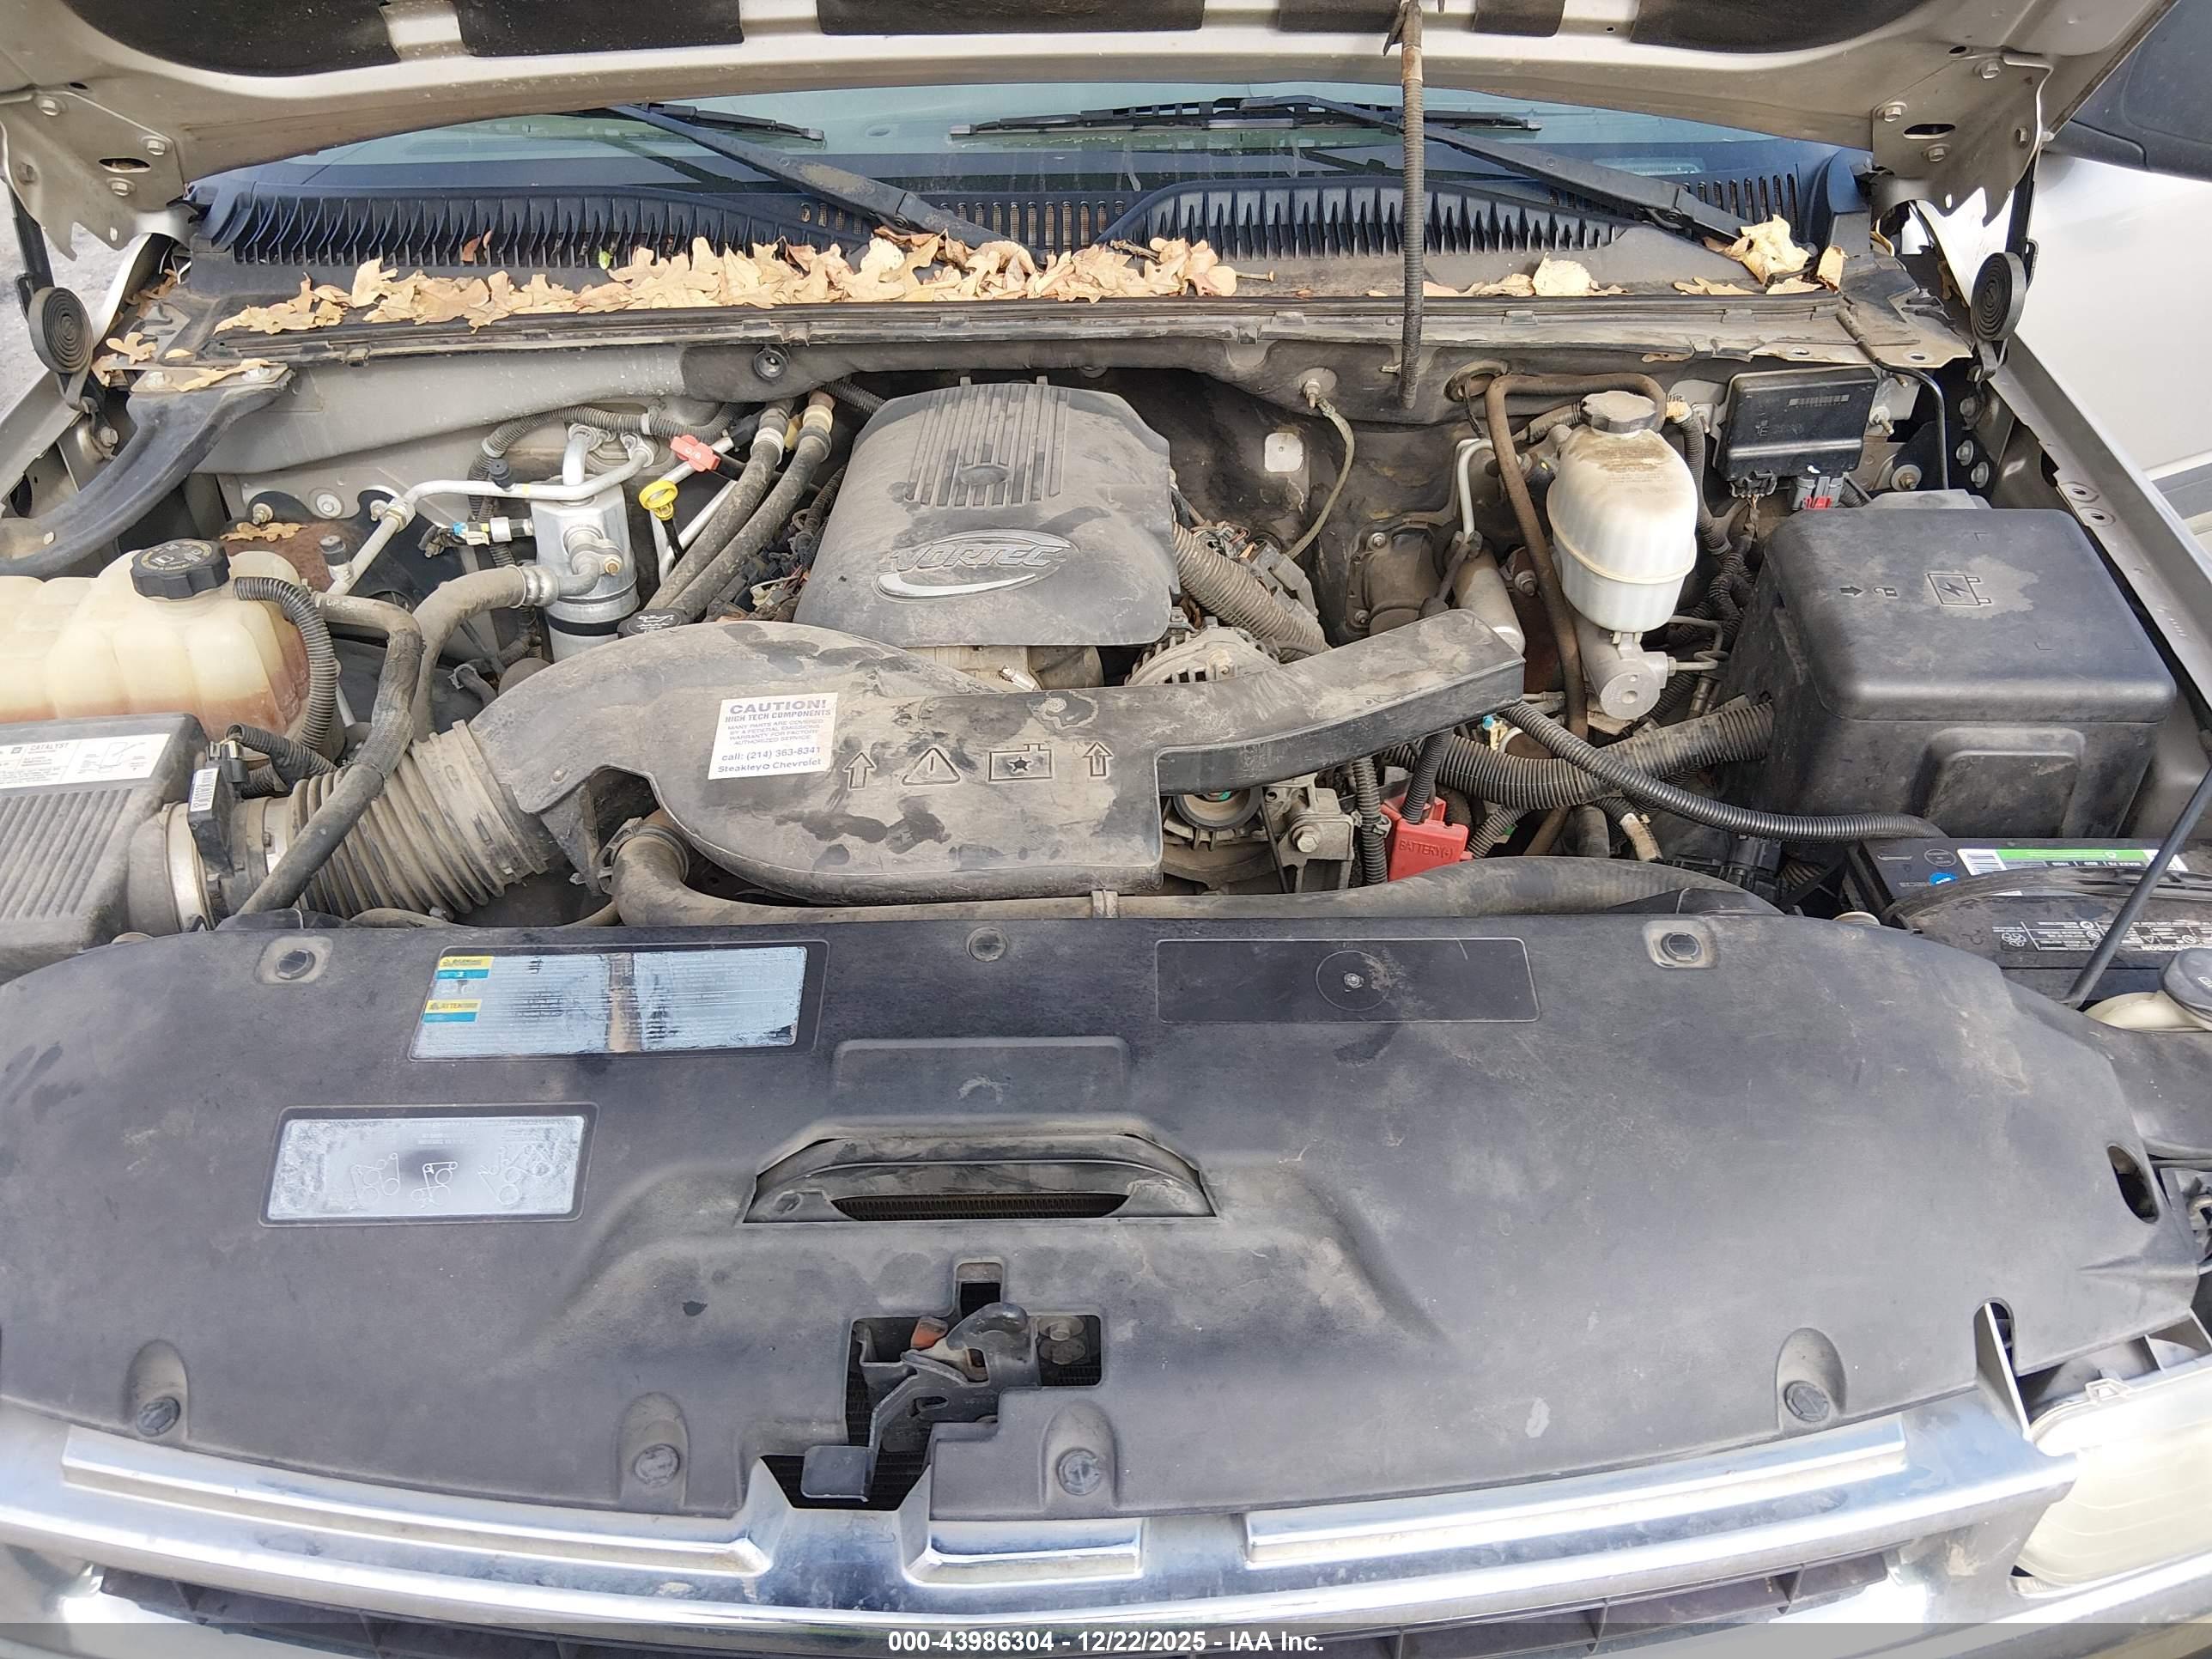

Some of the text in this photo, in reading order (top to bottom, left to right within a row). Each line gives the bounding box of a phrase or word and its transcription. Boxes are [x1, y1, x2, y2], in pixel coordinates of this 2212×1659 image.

[889, 544, 1065, 572] VORTEC
[730, 700, 827, 714] CAUTION!
[771, 709, 831, 719] COMPONENTS
[734, 737, 779, 745] AUTHORIZED
[721, 746, 822, 762] call: (214) 363-8341
[772, 758, 822, 769] Chevrolet
